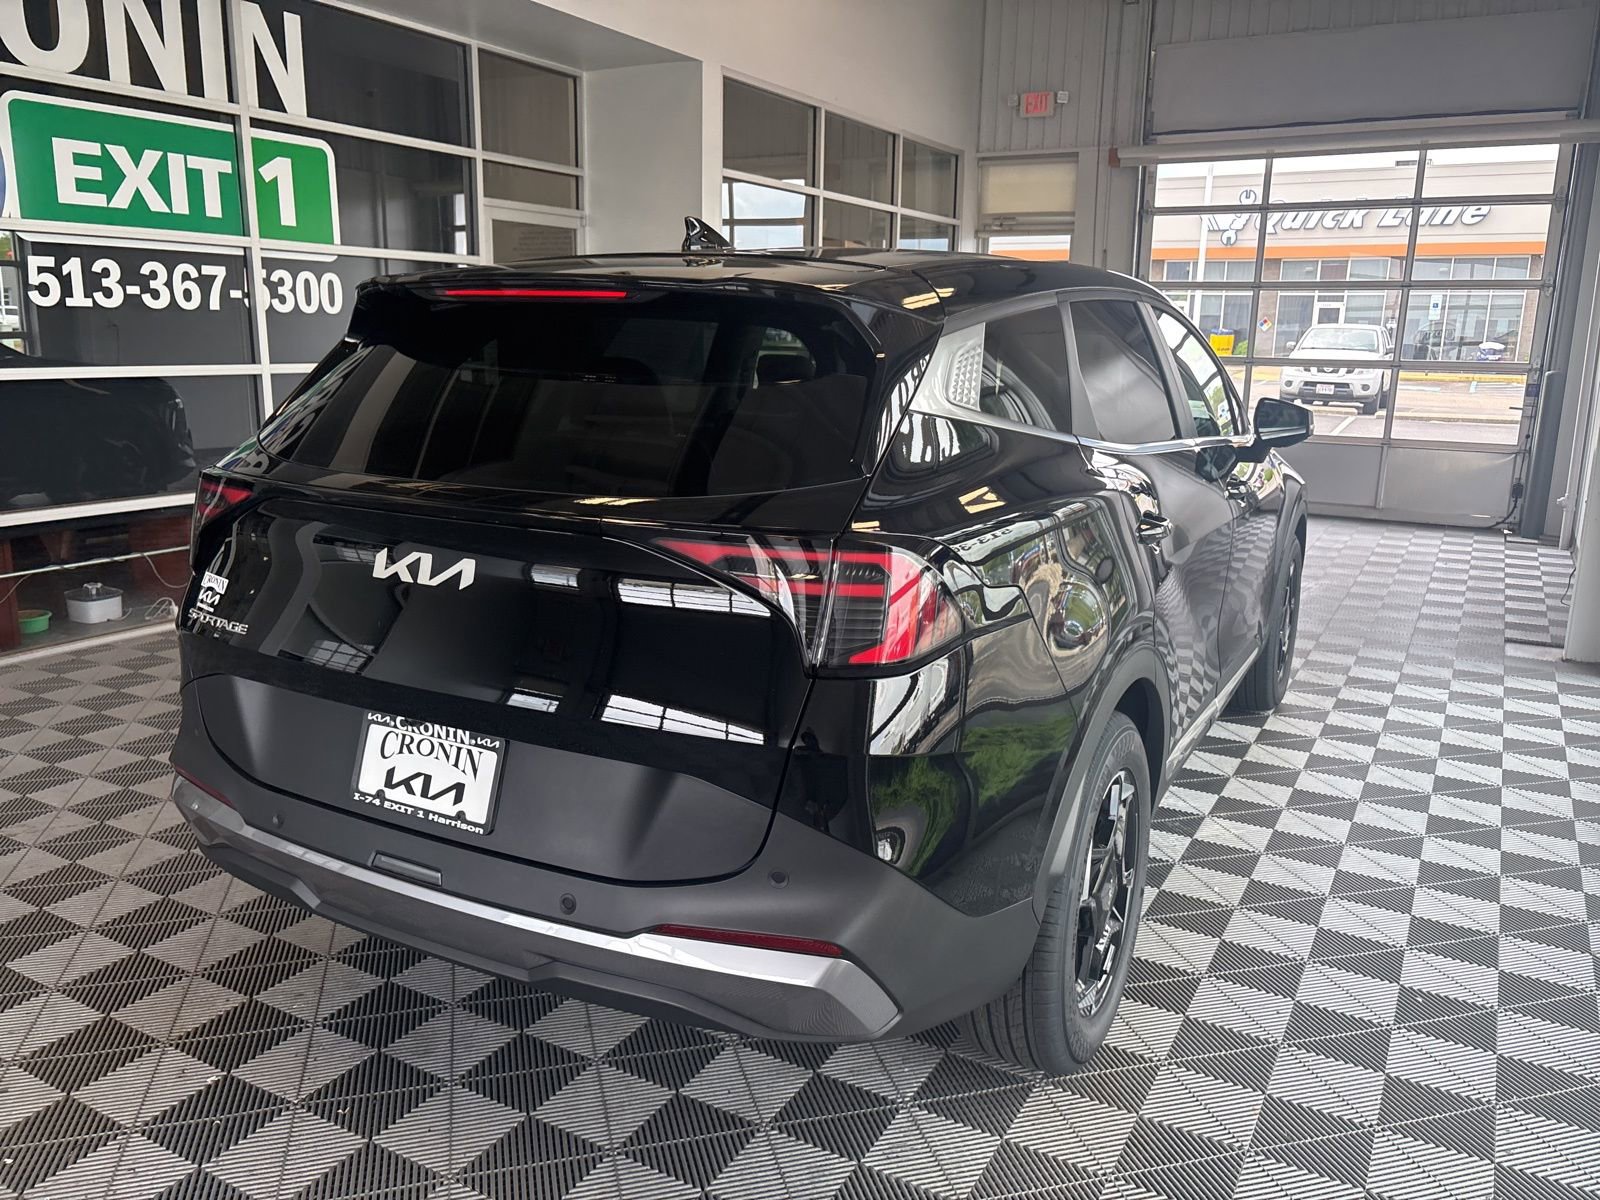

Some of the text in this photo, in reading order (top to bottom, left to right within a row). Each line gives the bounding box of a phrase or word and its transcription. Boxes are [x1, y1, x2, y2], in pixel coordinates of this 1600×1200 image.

[1024, 92, 1051, 115] EXIT
[51, 136, 297, 227] EXIT 1
[1254, 195, 1492, 235] Quick Lane
[27, 254, 343, 315] 513-367-5300
[372, 547, 476, 590] KIA
[188, 607, 249, 635] SPORTAGE
[380, 730, 484, 782] CRONIN
[384, 765, 466, 806] KIA
[353, 792, 485, 835] I-74 EXIT 1 Harrison
